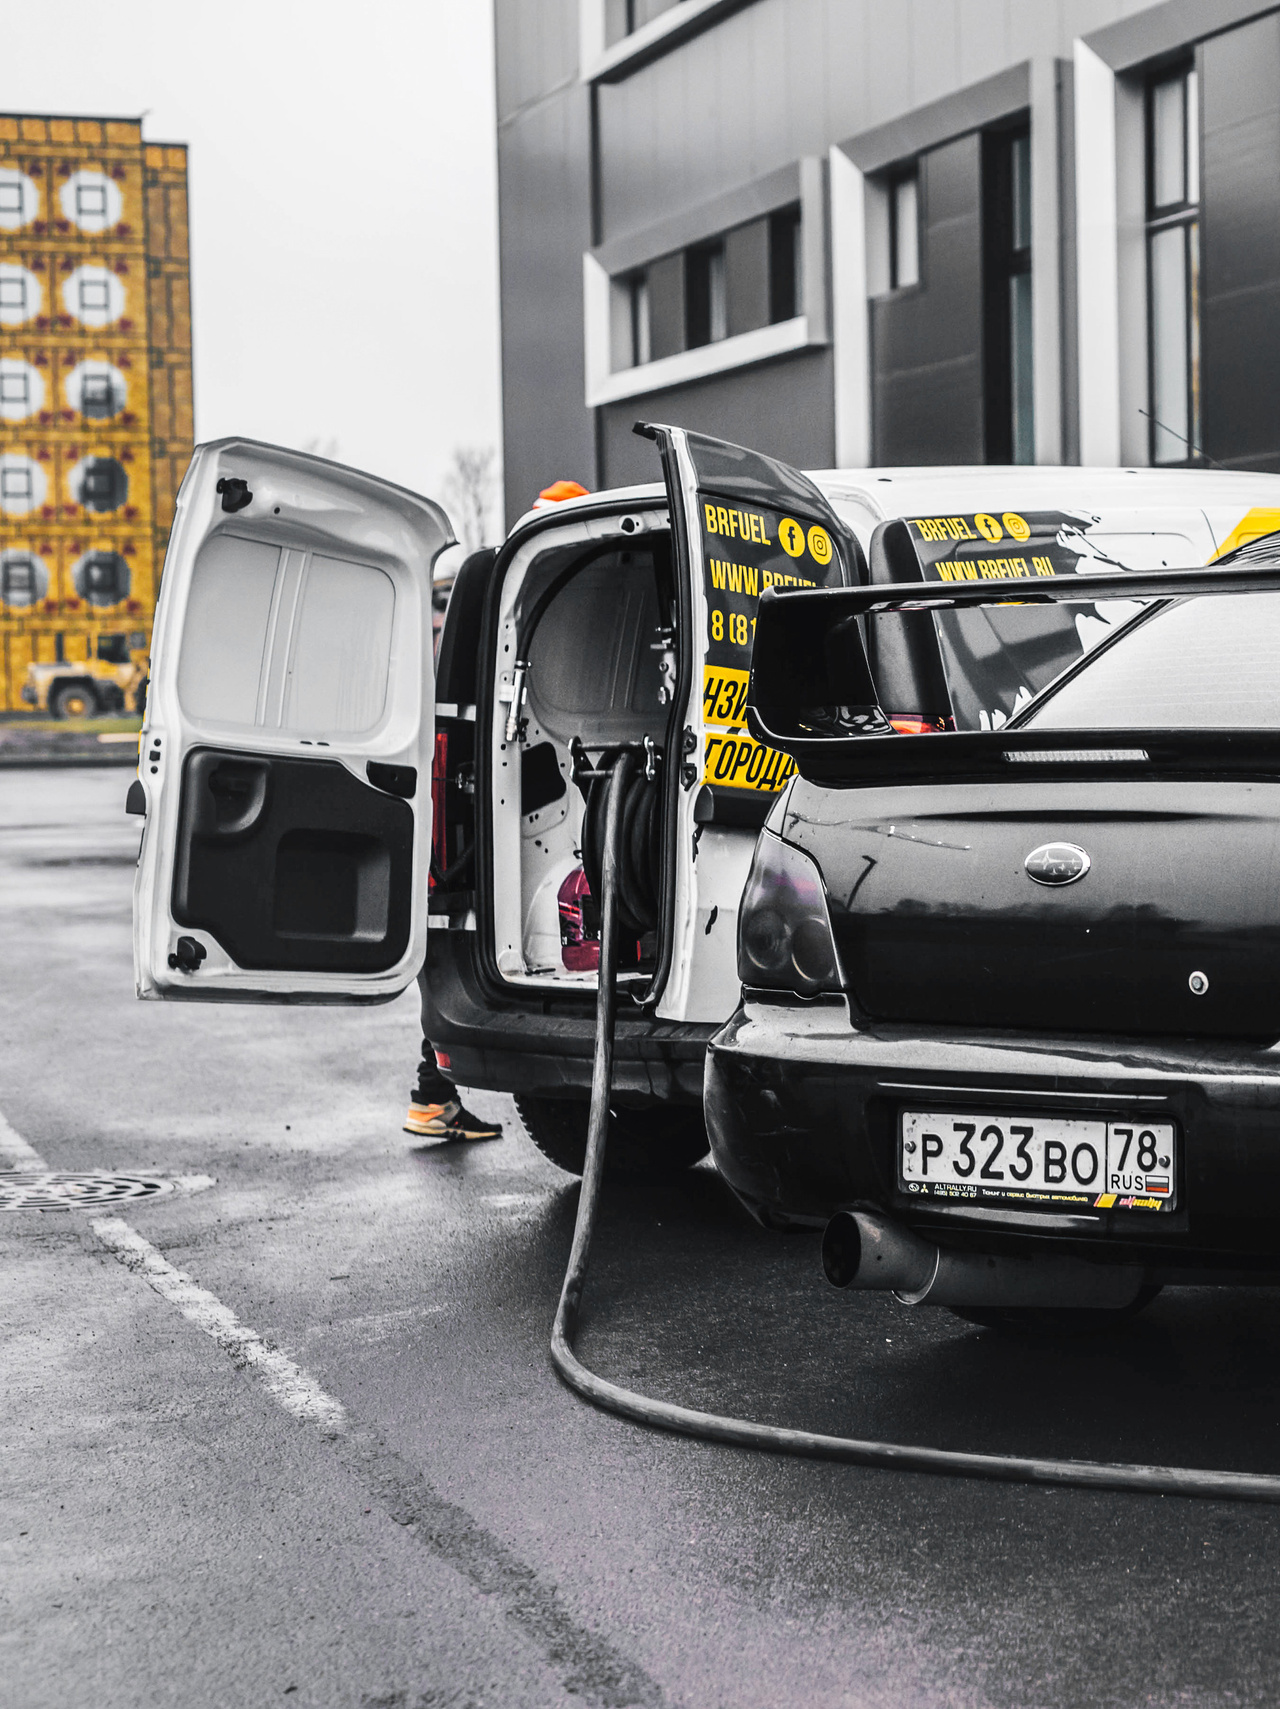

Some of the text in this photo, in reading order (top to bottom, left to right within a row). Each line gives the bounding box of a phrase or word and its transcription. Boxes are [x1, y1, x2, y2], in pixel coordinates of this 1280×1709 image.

[704, 503, 772, 546] BRFUEL
[914, 517, 977, 542] BRFUEL
[934, 555, 1056, 582] WWWBRFUELRU
[711, 609, 724, 642] 8
[1113, 1128, 1158, 1173] 78
[934, 1183, 978, 1193] ALTRALLY.RU
[1111, 1173, 1144, 1192] RUS
